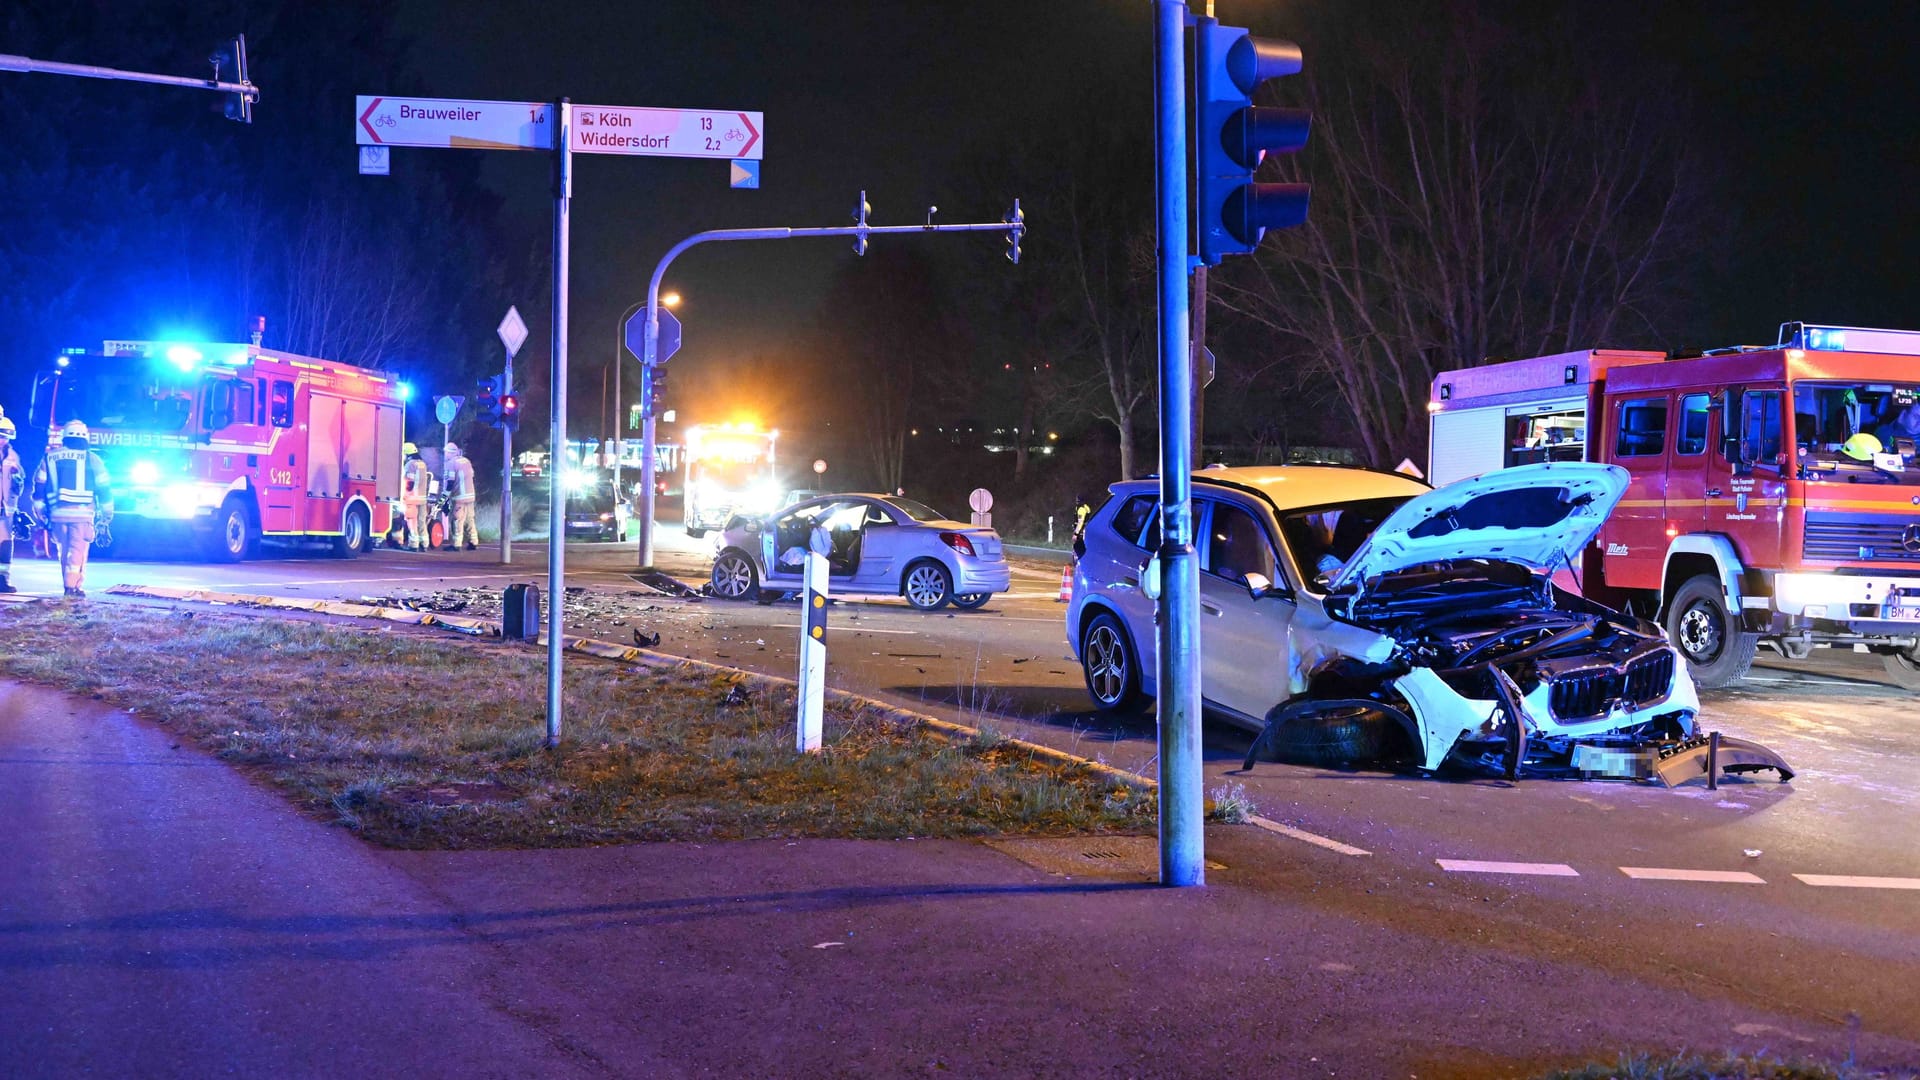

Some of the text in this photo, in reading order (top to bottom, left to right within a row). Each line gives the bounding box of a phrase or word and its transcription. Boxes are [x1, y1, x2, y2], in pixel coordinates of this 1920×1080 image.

[400, 104, 545, 124] Brauweiler 1,6
[599, 111, 713, 131] Köln 13
[580, 131, 721, 151] Widdersdorf 2,2
[277, 470, 291, 485] 112
[1891, 606, 1905, 618] BM
